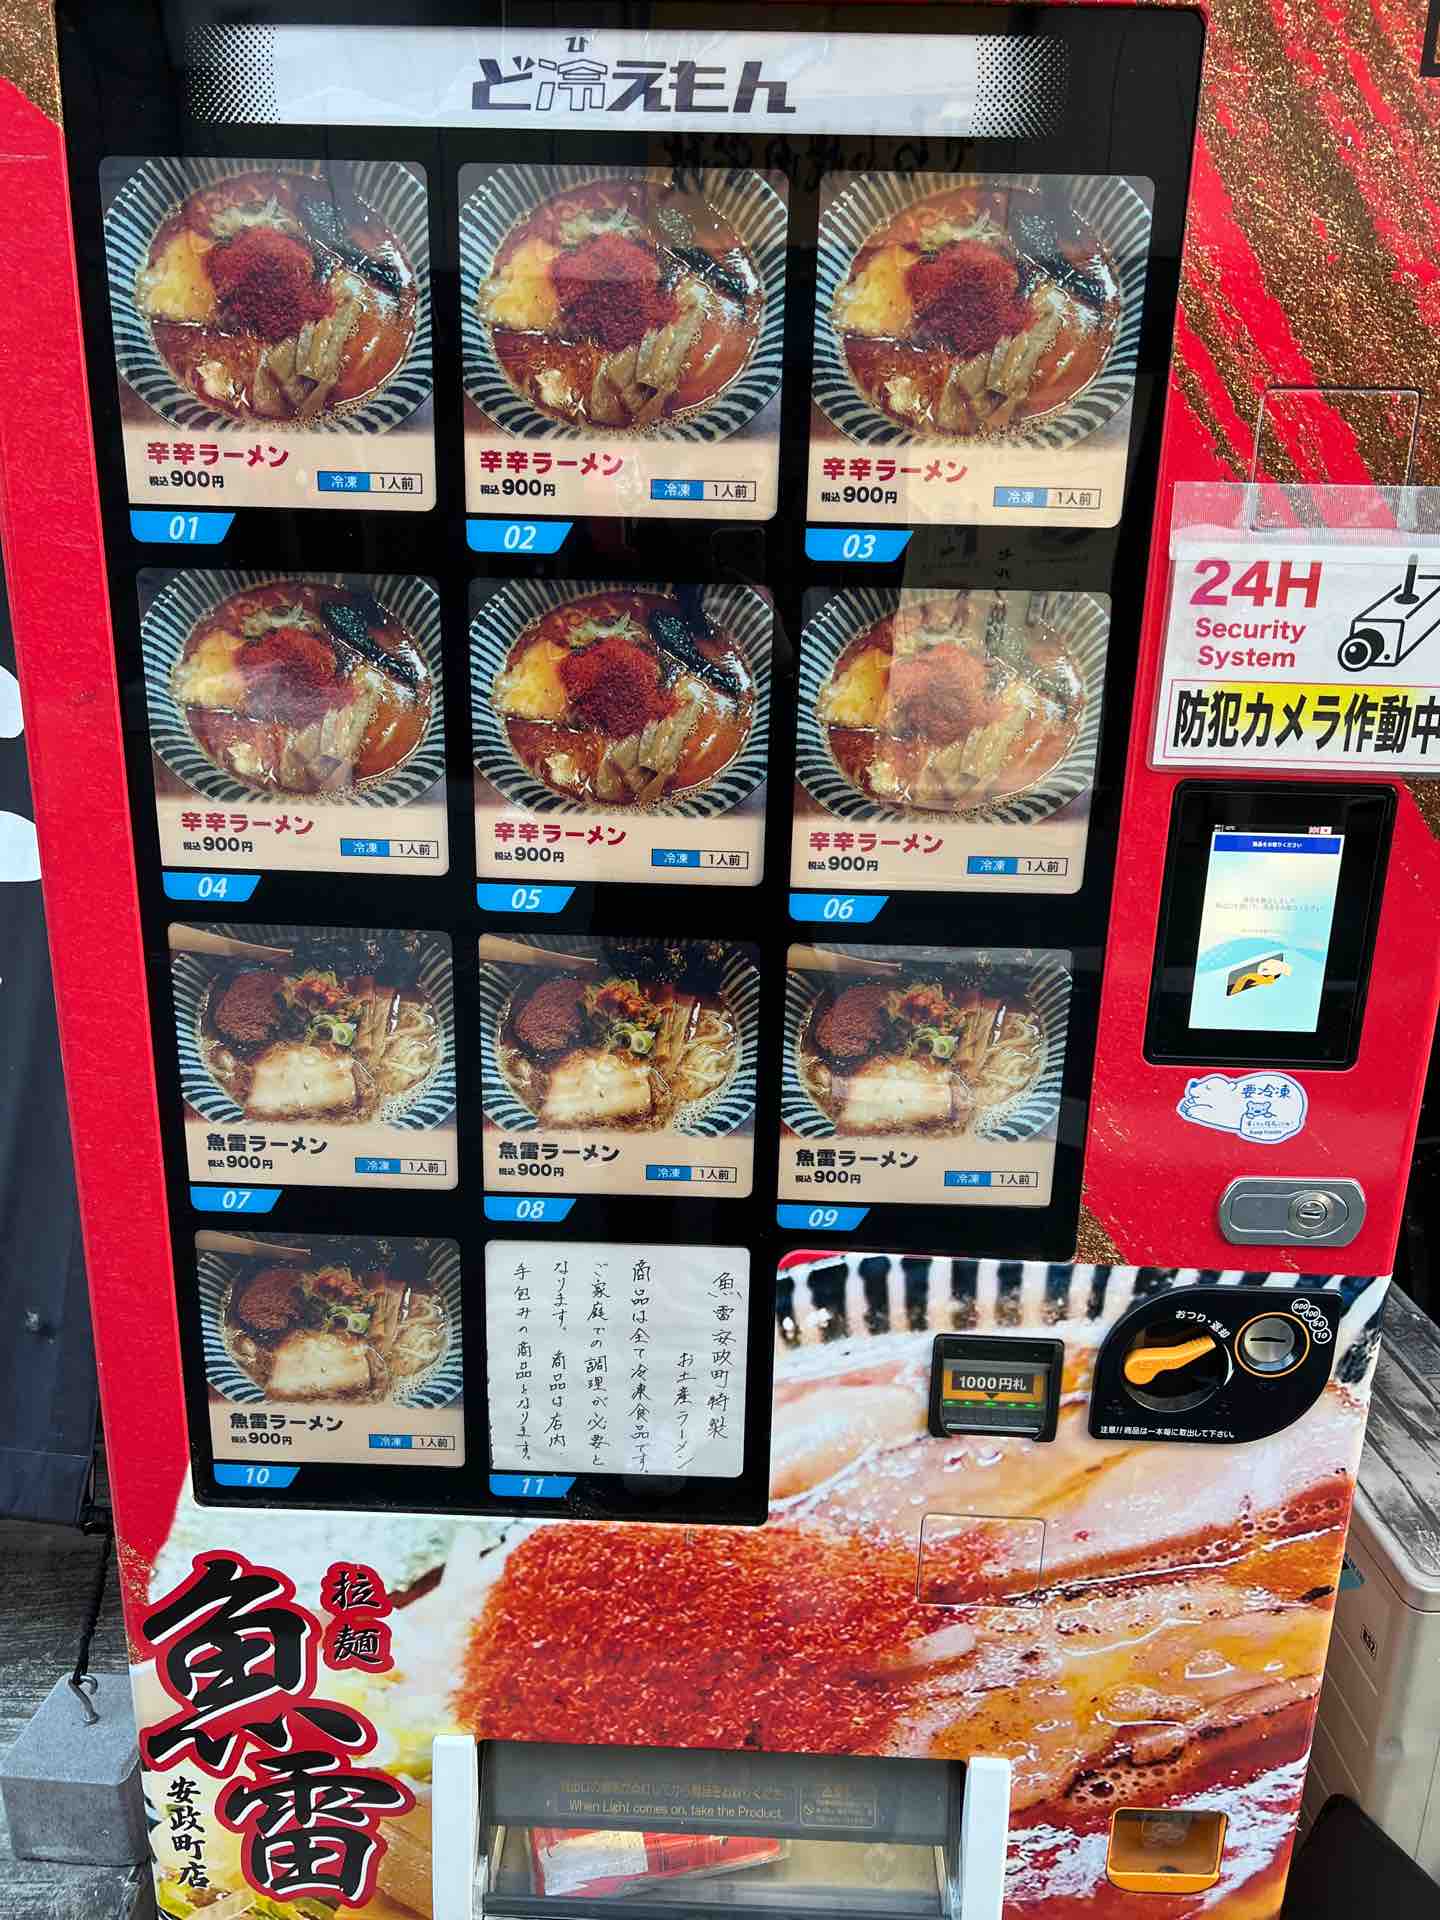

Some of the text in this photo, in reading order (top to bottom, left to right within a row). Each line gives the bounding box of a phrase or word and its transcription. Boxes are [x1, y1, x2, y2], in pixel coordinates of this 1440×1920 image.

[471, 55, 796, 113] ど冷えもん
[147, 442, 289, 467] 辛辛ラーメン
[480, 450, 624, 475] 辛辛ラーメン
[823, 457, 968, 483] 辛辛ラーメン
[331, 475, 414, 490] 冷凍 1人前
[664, 483, 747, 498] 冷凍 1人前
[1007, 489, 1091, 506] 冷凍 1人前
[169, 515, 199, 540] 01
[503, 525, 537, 549] 02
[843, 534, 876, 559] 03
[1189, 557, 1323, 608] 24H
[1195, 617, 1306, 644] Security
[1197, 645, 1296, 670] System
[1172, 688, 1440, 754] 防犯カメラ作動中
[181, 812, 315, 834] 辛辛ラーメン
[494, 822, 626, 845] 辛辛ラーメン
[809, 832, 944, 853] 辛辛ラーメン
[353, 841, 431, 856] 冷凍 1人前
[663, 851, 740, 866] 冷凍 1人前
[980, 859, 1059, 873] 冷凍 1人前
[197, 877, 228, 898] 04
[511, 888, 542, 909] 05
[823, 899, 855, 919] 06
[1241, 1084, 1290, 1099] 要冷凍
[206, 1134, 327, 1154] 魚雷ラーメン
[498, 1142, 620, 1162] 魚雷ラーメン
[366, 1160, 439, 1173] 冷凍 1人前
[796, 1149, 918, 1168] 魚雷ラーメン
[657, 1167, 729, 1180] 冷凍 1人前
[957, 1173, 1030, 1185] 冷凍 1人前
[222, 1191, 250, 1209] 07
[516, 1200, 545, 1218] 08
[808, 1209, 838, 1227] 09
[707, 1271, 742, 1439] 魚雷安政町特製
[960, 1376, 1026, 1391] 1000円札
[673, 1352, 697, 1470] お土産ラーメン
[230, 1413, 343, 1432] 魚雷ラーメン
[420, 1438, 448, 1448] 1人前
[246, 1468, 270, 1485] 10
[521, 1478, 545, 1494] 11
[143, 1557, 406, 1902] 魚雷
[167, 1776, 210, 1889] 安政町店
